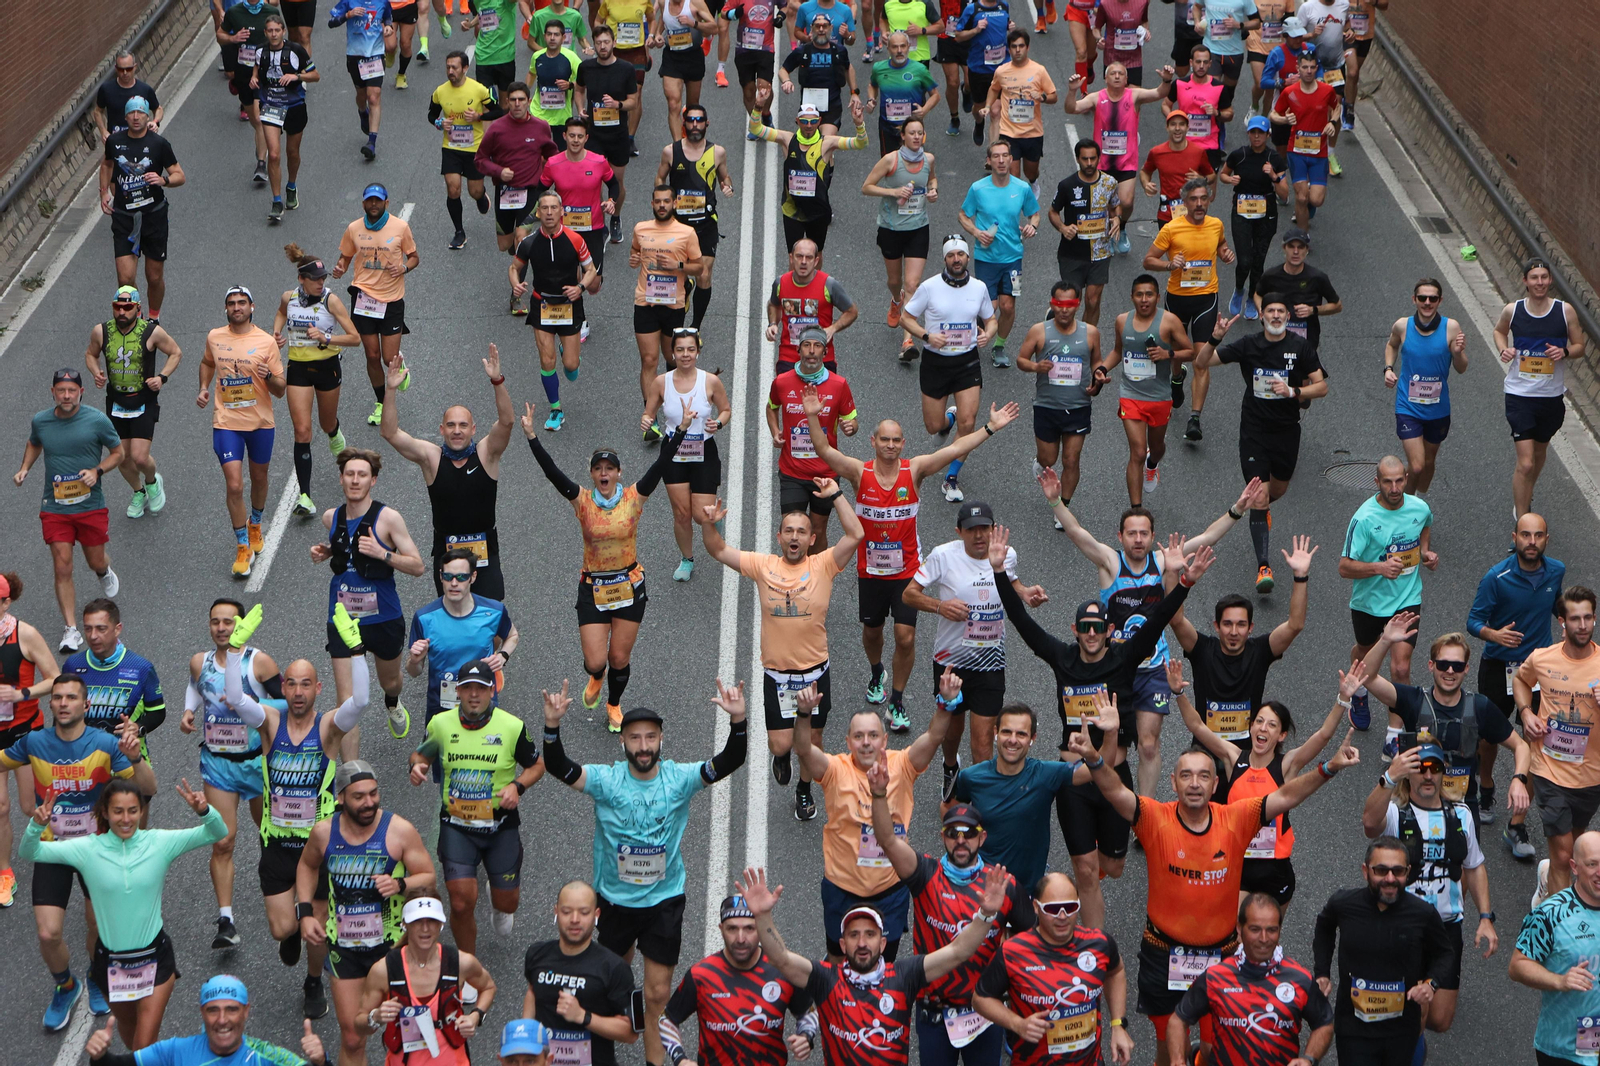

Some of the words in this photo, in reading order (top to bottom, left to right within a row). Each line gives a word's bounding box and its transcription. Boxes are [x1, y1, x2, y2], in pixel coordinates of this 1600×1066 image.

[873, 508, 886, 516] Vale
[459, 533, 482, 542] ZURICH
[1400, 541, 1418, 550] ZURICH
[604, 576, 626, 584] ZURICH
[1076, 684, 1100, 694] ZURICH
[1550, 688, 1570, 696] Maratón
[87, 686, 132, 708] MATE
[1560, 724, 1586, 734] ZURICH
[1557, 736, 1572, 745] 7603
[270, 750, 322, 771] AMATE
[52, 766, 86, 778] NEVER
[270, 770, 322, 786] RUNNERS
[52, 780, 76, 792] GIVE
[78, 779, 93, 792] UP
[460, 790, 486, 799] ZURICH
[64, 804, 90, 814] ZURICH
[285, 802, 300, 810] 7692
[64, 819, 82, 827] 6534
[1168, 863, 1202, 880] NEVER
[1204, 866, 1228, 882] STOP
[1188, 878, 1224, 886] RUNNING
[348, 904, 375, 914] ZURICH
[348, 920, 366, 928] 7166
[926, 915, 956, 933] INGENIO
[1369, 982, 1398, 992] ZURICH
[1020, 992, 1054, 1005] INGENIO
[1368, 996, 1386, 1004] 6252
[1064, 1003, 1092, 1017] ZURICH
[706, 1020, 736, 1032] INGENIO
[1065, 1021, 1082, 1031] 6203
[556, 1032, 584, 1040] ZURICH
[830, 1022, 858, 1042] INGENIO
[886, 1024, 904, 1042] SPORT
[1053, 1036, 1074, 1044] BRUNO
[555, 1046, 573, 1055] 7115
